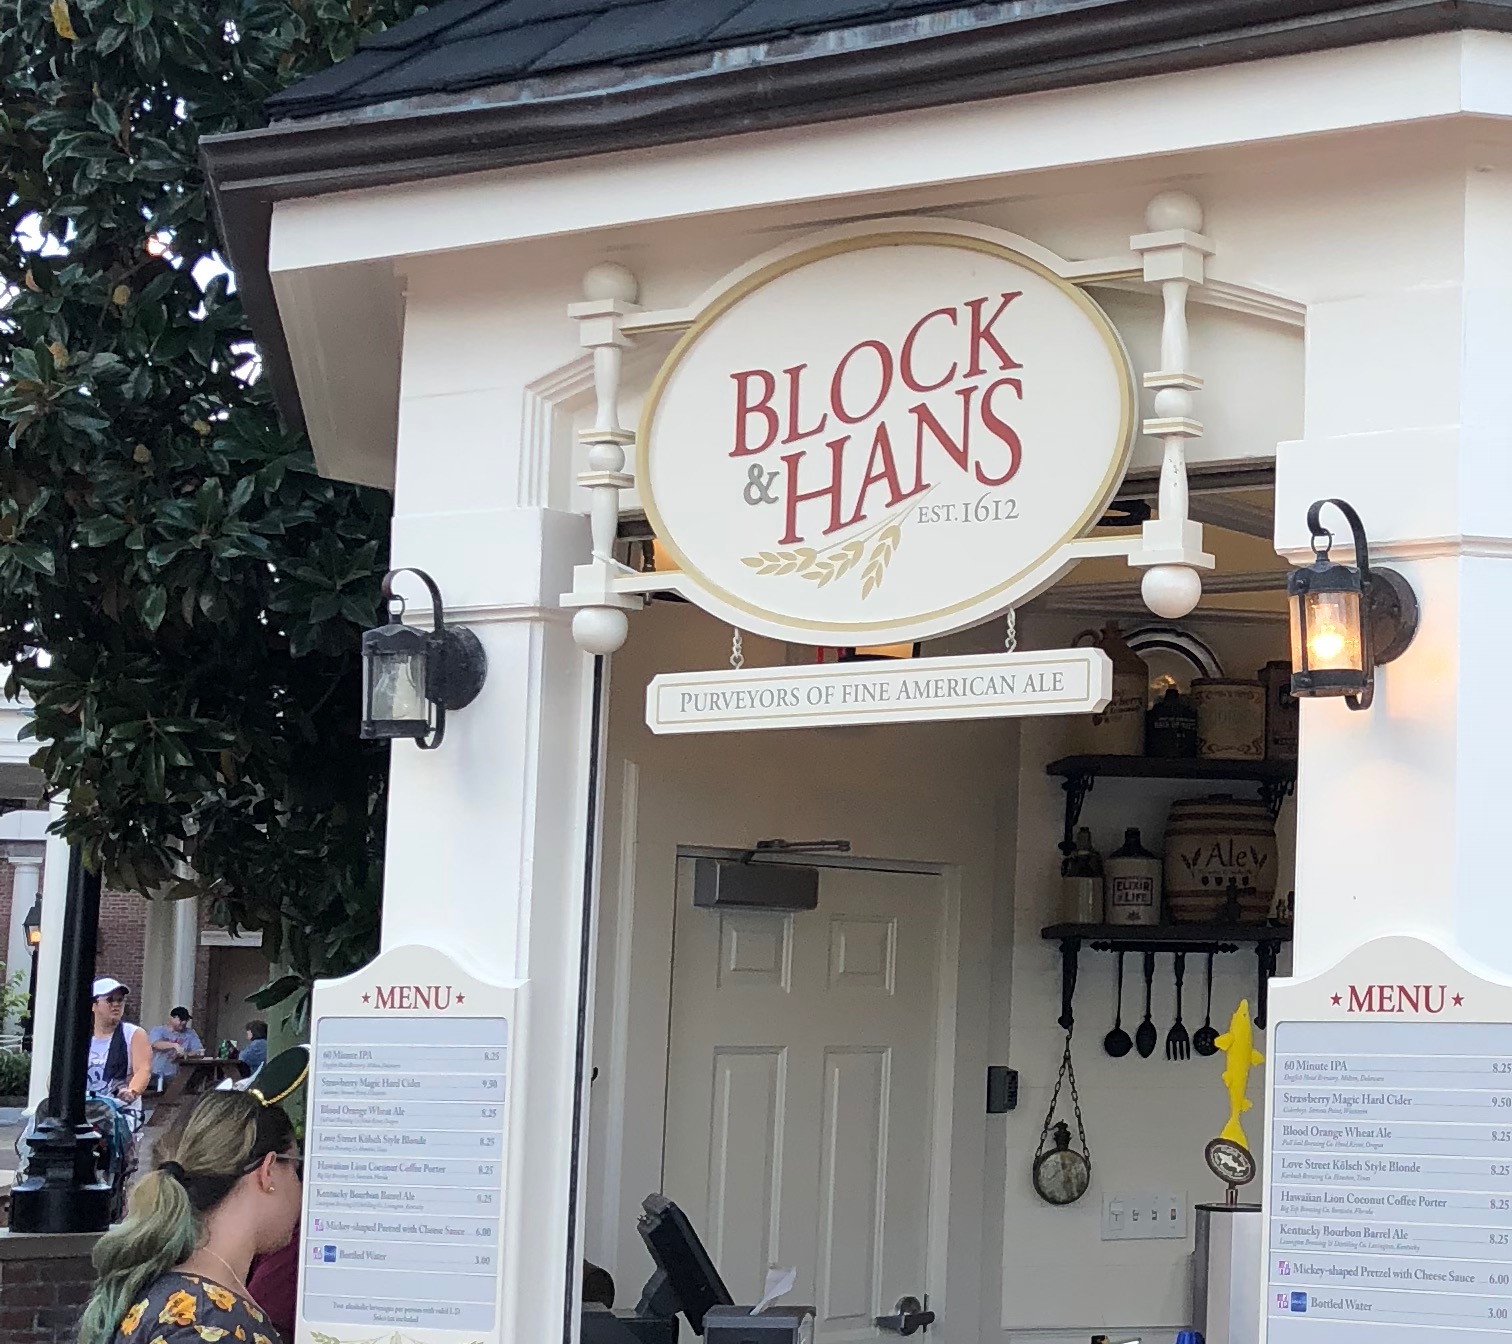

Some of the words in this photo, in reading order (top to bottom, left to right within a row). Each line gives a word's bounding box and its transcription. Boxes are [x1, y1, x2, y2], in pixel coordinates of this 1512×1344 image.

[729, 291, 1025, 457] BLOCK
[743, 464, 780, 506] &
[778, 378, 1025, 546] HANS
[918, 501, 958, 525] EST.
[961, 492, 1020, 525] 1612
[679, 685, 801, 714] PURVEYORS
[806, 684, 836, 707] OF
[841, 680, 891, 704] FINE
[896, 674, 1017, 701] AMERICAN
[1021, 671, 1065, 694] ALE
[1205, 838, 1247, 867] Ale
[1116, 880, 1150, 891] ELIXIR
[1124, 892, 1148, 903] LIFE
[374, 985, 452, 1010] MENU
[1347, 985, 1446, 1013] MENU
[359, 1051, 372, 1060] IPA
[1284, 1060, 1295, 1071] 60
[1296, 1060, 1328, 1071] Minute
[1330, 1060, 1347, 1071] IPA
[1492, 1063, 1512, 1073] 8.25
[321, 1078, 358, 1089] Strawberry
[360, 1079, 380, 1089] Magic
[382, 1079, 400, 1088] Hard
[1283, 1092, 1330, 1107] Strawberry
[1332, 1094, 1359, 1107] Magic
[1362, 1094, 1384, 1105] Hard
[1387, 1095, 1412, 1106] Cider
[1492, 1097, 1511, 1108] 9.50
[321, 1105, 340, 1115] Blood
[342, 1106, 367, 1117] Orange
[368, 1107, 391, 1116] Wheat
[392, 1107, 405, 1116] Ale
[319, 1134, 336, 1143] Love
[383, 1135, 400, 1146] Style
[402, 1136, 426, 1145] Blonde
[1283, 1126, 1308, 1137] Blood
[1311, 1126, 1343, 1140] Orange
[1345, 1127, 1374, 1138] Wheat
[1374, 1128, 1391, 1138] Ale
[1492, 1131, 1511, 1142] 8.25
[351, 1162, 367, 1171] Lion
[368, 1162, 398, 1172] Coconut
[399, 1163, 422, 1173] Coffee
[423, 1164, 446, 1174] Porter
[1282, 1159, 1304, 1170] Love
[1305, 1159, 1330, 1170] Street
[1333, 1159, 1362, 1171] Kölsch
[1364, 1160, 1387, 1173] Style
[1389, 1162, 1421, 1173] Blonde
[1490, 1165, 1510, 1176] 8.25
[316, 1189, 348, 1202] Kentucky
[350, 1191, 379, 1200] Bourbon
[403, 1192, 415, 1201] Ale
[1280, 1191, 1322, 1203] Hawaiian
[1324, 1192, 1344, 1204] Lion
[1347, 1193, 1385, 1205] Coconut
[1387, 1194, 1416, 1206] Coffee
[1418, 1196, 1447, 1208] Porter
[1490, 1200, 1510, 1210] 8.25
[402, 1223, 417, 1233] with
[1280, 1224, 1321, 1238] Kentucky
[1323, 1226, 1362, 1238] Bourbon
[1364, 1228, 1390, 1240] Barrel
[1392, 1228, 1408, 1240] Ale
[1489, 1234, 1508, 1244] 8.25
[340, 1250, 364, 1261] Bottled
[366, 1251, 387, 1261] Water
[1293, 1262, 1359, 1279] Mickey-shaped
[1360, 1266, 1391, 1278] Pretzel
[1392, 1268, 1412, 1280] with
[1414, 1268, 1447, 1281] Cheese
[1448, 1270, 1475, 1283] Sauce
[1489, 1274, 1509, 1284] 6.00
[1311, 1297, 1344, 1310] Bottled
[1345, 1298, 1372, 1311] Water
[1488, 1308, 1508, 1319] 3.00
